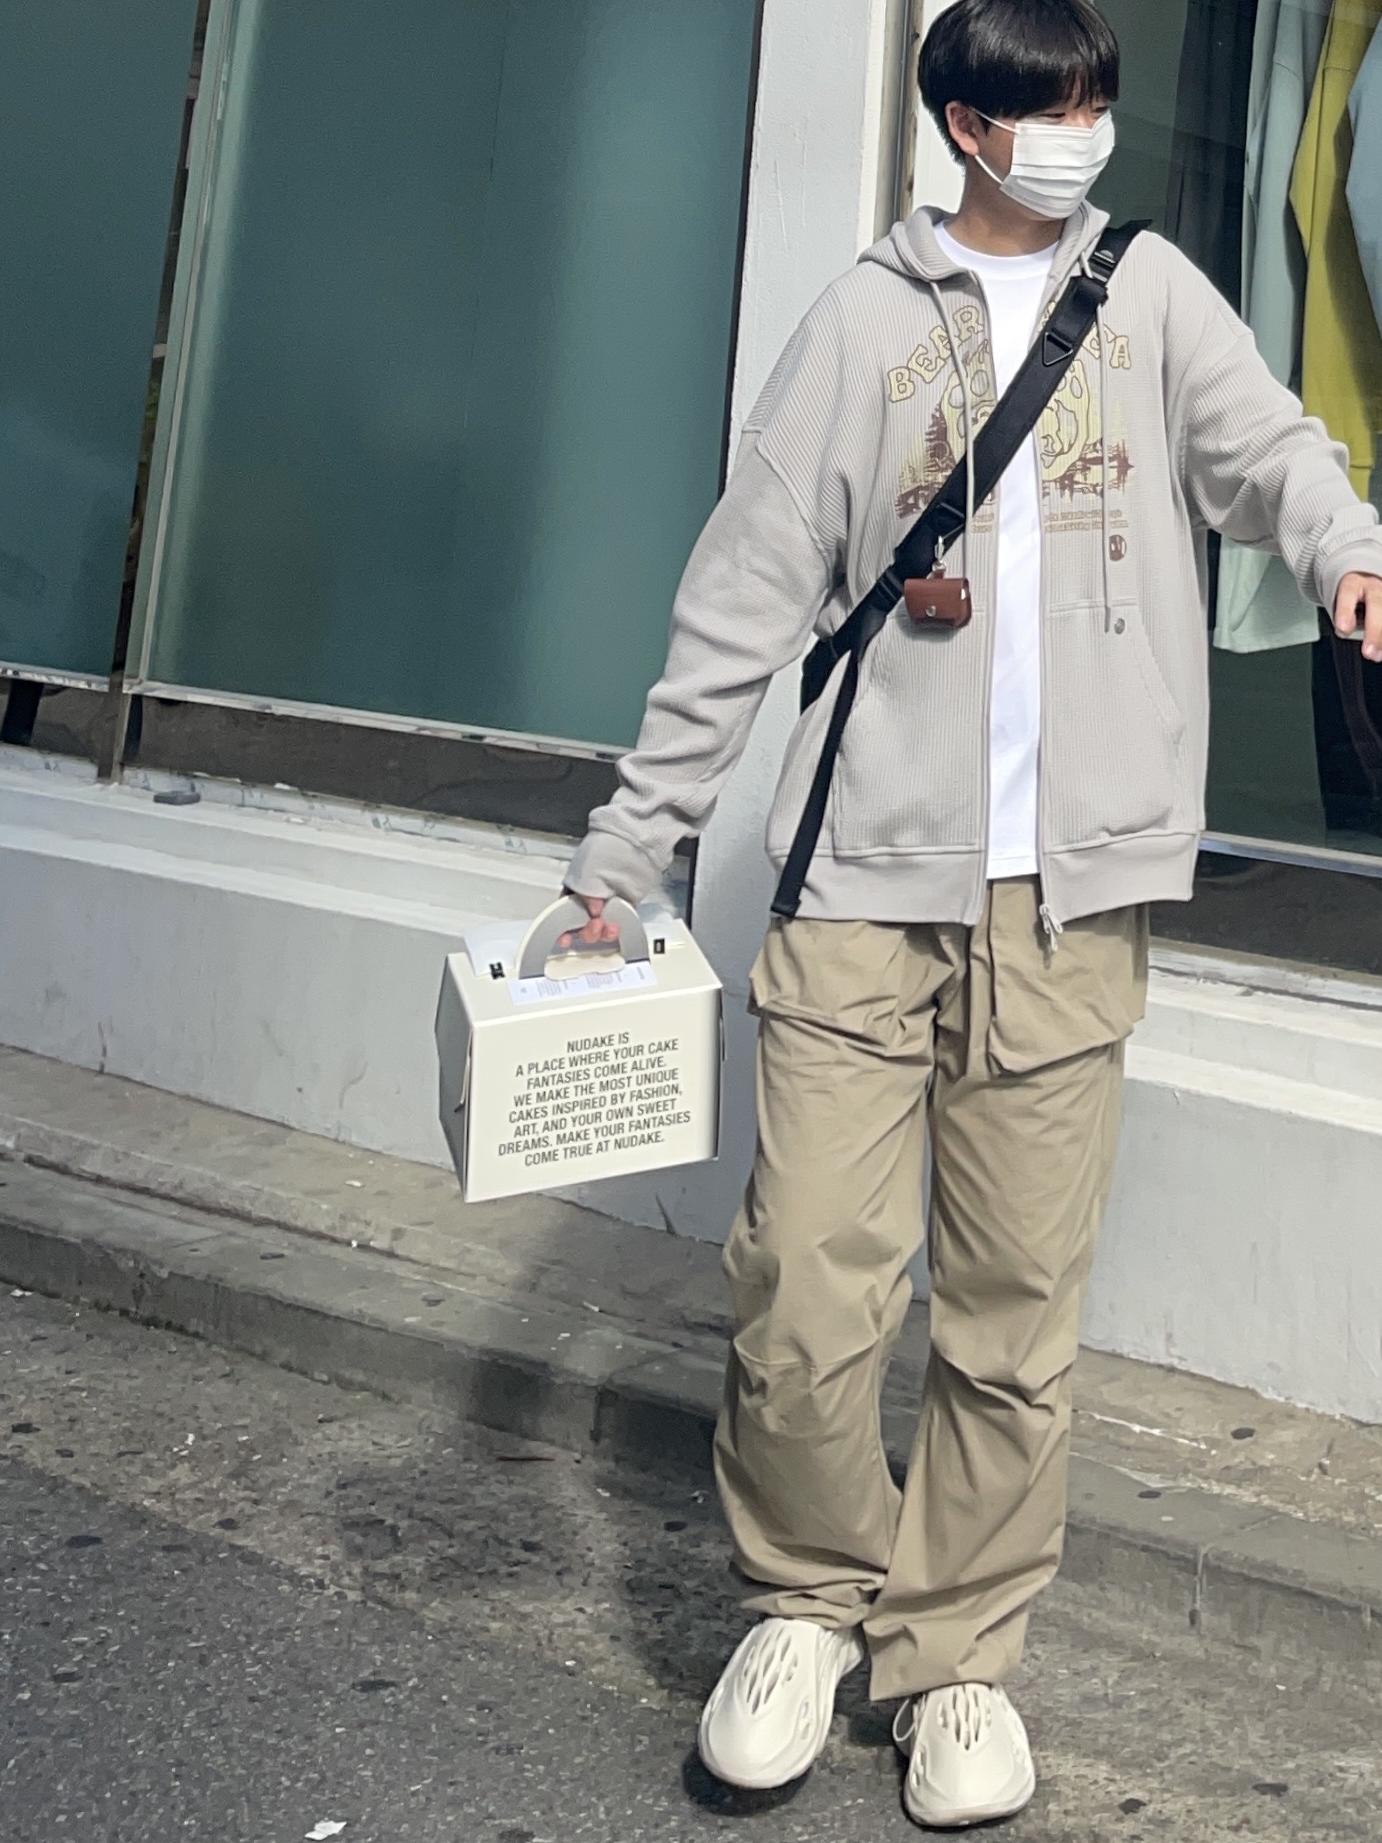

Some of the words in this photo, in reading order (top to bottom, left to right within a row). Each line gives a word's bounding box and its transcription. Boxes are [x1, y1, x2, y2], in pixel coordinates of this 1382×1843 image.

[516, 1065, 523, 1077] A
[528, 1058, 565, 1074] PLACE
[569, 1050, 609, 1068] WHERE
[614, 1045, 644, 1060] YOUR
[648, 1038, 679, 1054] CAKE
[567, 1034, 614, 1053] NUDAKE
[619, 1032, 629, 1044] IS
[514, 1094, 532, 1107] WE
[536, 1087, 570, 1103] MAKE
[574, 1083, 595, 1097] THE
[600, 1076, 632, 1092] MOST
[636, 1068, 679, 1085] UNIQUE
[527, 1069, 590, 1090] FANTASIES
[594, 1063, 627, 1078] COME
[631, 1056, 666, 1072] ALIVE.
[509, 1107, 547, 1123] CAKES
[552, 1095, 606, 1115] INSPIRED
[611, 1092, 625, 1104] BY
[630, 1084, 682, 1102] FASHION,
[514, 1123, 538, 1138] ART,
[542, 1118, 566, 1133] AND
[571, 1112, 601, 1128] YOUR
[606, 1106, 633, 1121] OWN
[637, 1099, 677, 1116] SWEET
[498, 1137, 552, 1156] DREAMS.
[556, 1129, 589, 1145] MAKE
[594, 1123, 624, 1138] YOUR
[629, 1111, 691, 1132] FANTASIES
[525, 1150, 559, 1166] COME
[563, 1144, 592, 1159] TRUE
[596, 1140, 609, 1153] AT
[614, 1131, 665, 1150] NUDAKE.
